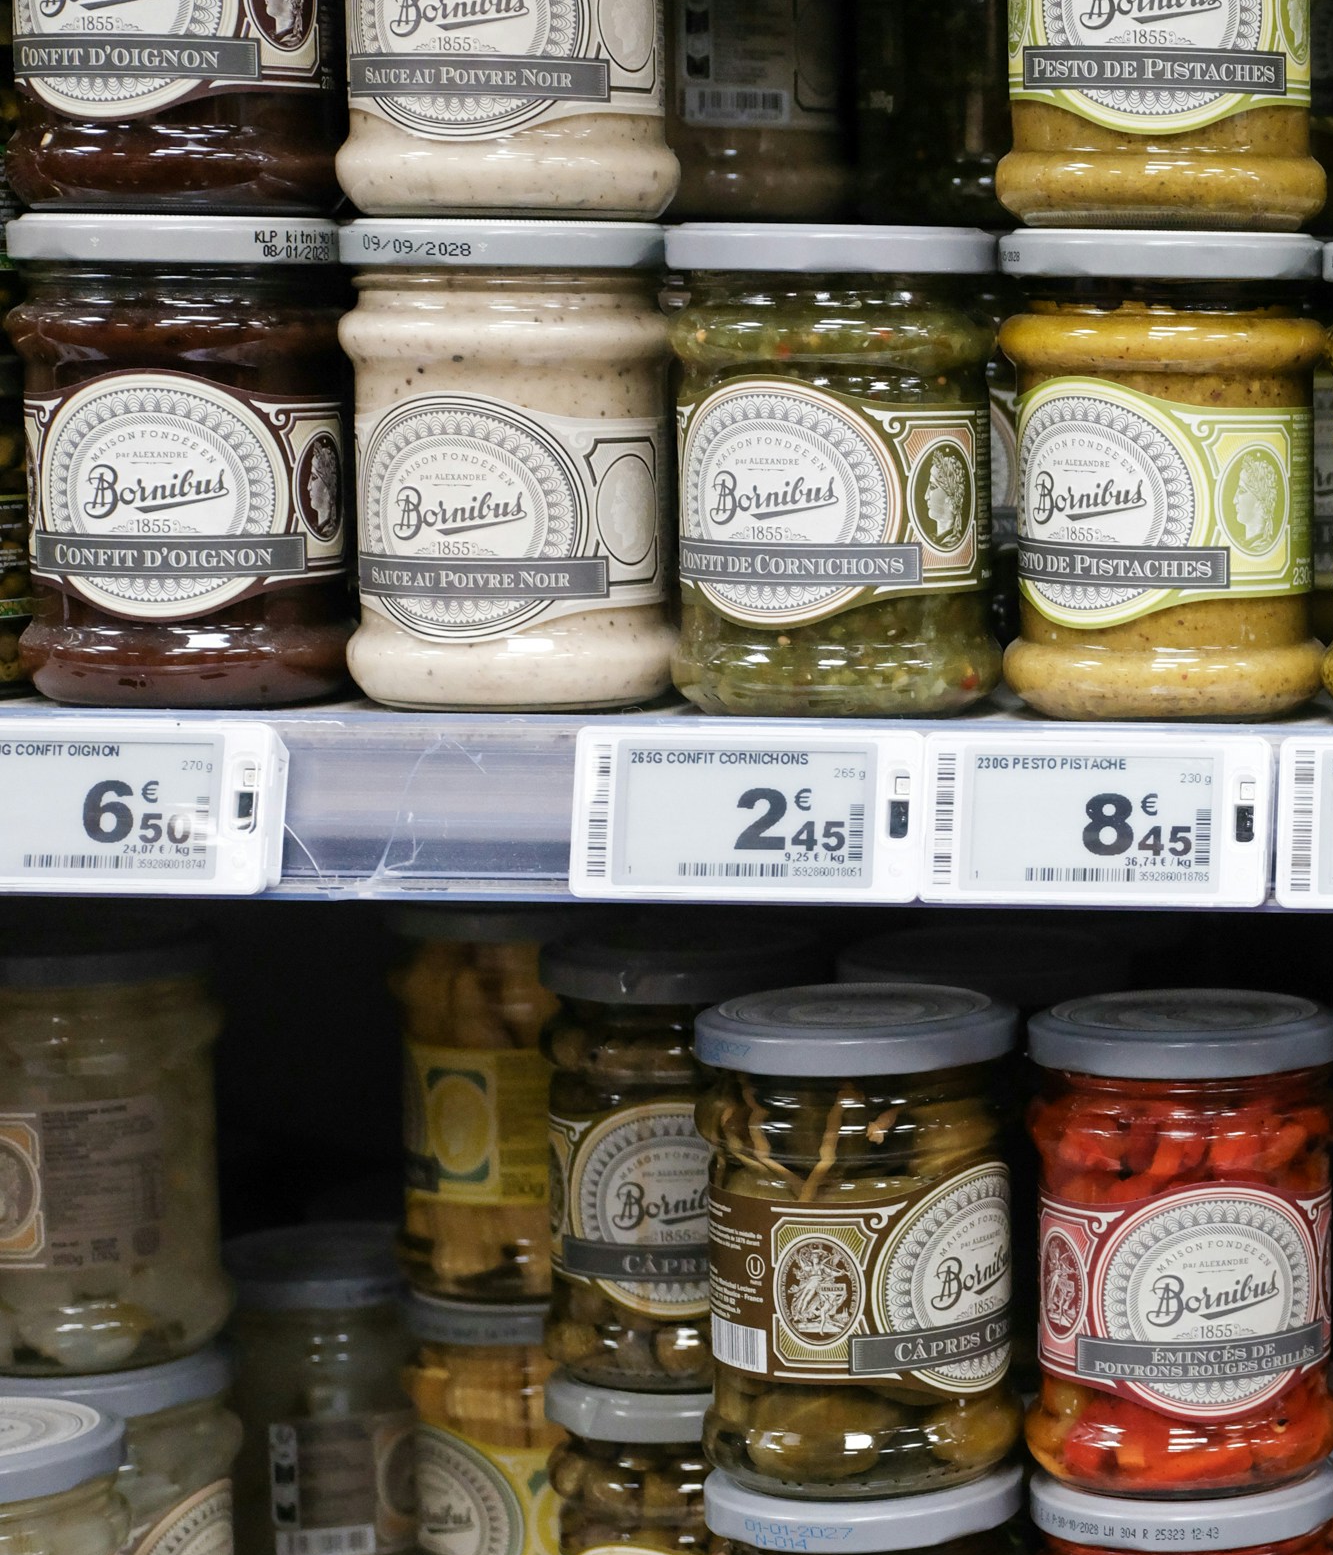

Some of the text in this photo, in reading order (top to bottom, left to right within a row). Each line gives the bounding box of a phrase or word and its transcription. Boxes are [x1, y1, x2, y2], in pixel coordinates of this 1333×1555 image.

[21, 46, 219, 69] CONFIT D'OIGNON
[365, 66, 571, 88] SAUCE AU POIVRE NOIR
[1032, 58, 1276, 84] PESTO DE PISTACHES
[667, 752, 715, 765] CONFIT
[720, 752, 809, 766] CORNICHONS
[977, 758, 1126, 772] 230G PESTO PISTACHE
[1146, 1271, 1281, 1325] Bornibus
[1152, 1345, 1275, 1365] ÉMINCÉS DE
[1095, 1361, 1184, 1376] POIVRONS
[1188, 1357, 1260, 1375] ROUGES
